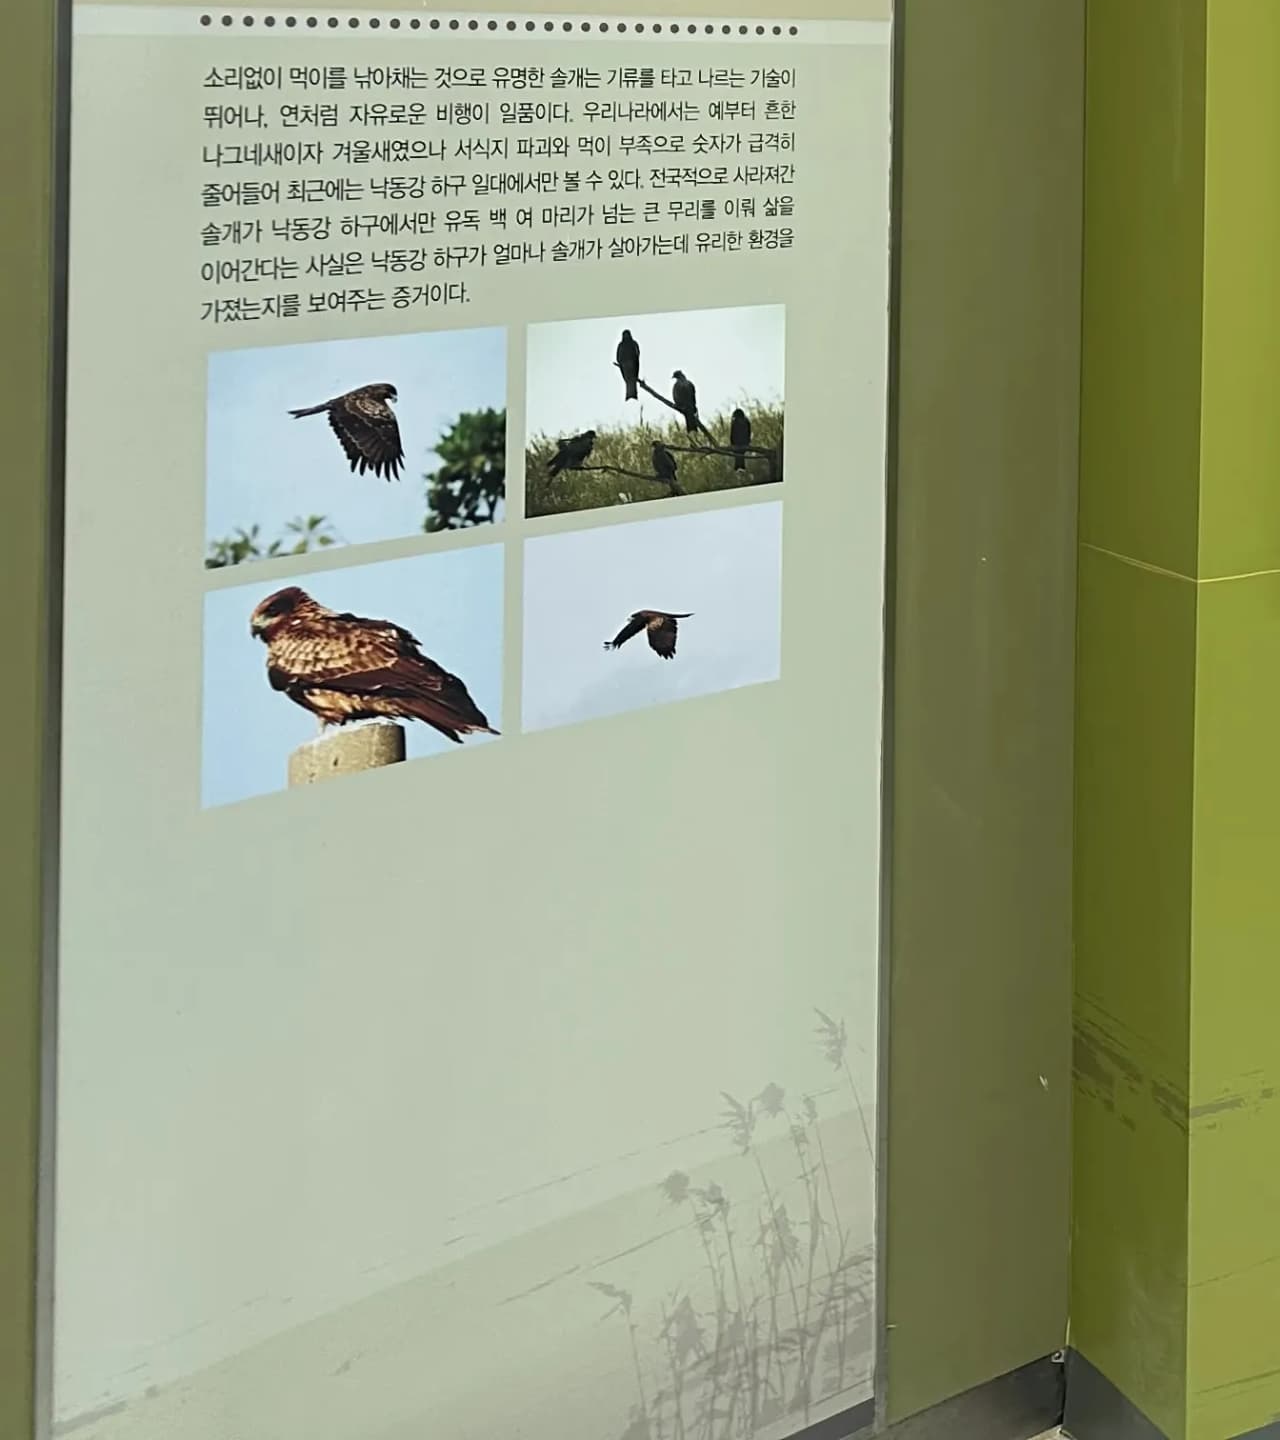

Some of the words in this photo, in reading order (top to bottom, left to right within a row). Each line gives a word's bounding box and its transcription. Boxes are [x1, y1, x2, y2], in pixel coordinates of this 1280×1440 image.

[204, 67, 281, 90] 소리없이
[290, 67, 347, 89] 먹이를
[435, 67, 487, 88] 것으로
[492, 67, 545, 89] 유명한
[550, 68, 601, 88] 솔개는
[607, 68, 655, 88] 기류를
[661, 68, 692, 88] 타고
[699, 69, 745, 88] 나르는
[751, 69, 795, 88] 기술이
[280, 104, 337, 127] 연처럼
[349, 103, 426, 126] 자유로운
[437, 103, 488, 125] 비행이
[500, 102, 573, 123] 일품이다.
[583, 101, 699, 122] 우리나라에서는
[709, 101, 755, 120] 예부터
[765, 100, 796, 119] 흔한
[203, 142, 323, 167] 나그네새이자
[333, 139, 446, 163] 겨울새였으나
[455, 138, 507, 160] 서식지
[517, 137, 569, 158] 파괴와
[578, 136, 610, 156] 먹이
[619, 136, 685, 155] 부족으로
[692, 133, 741, 154] 숫자가
[748, 132, 794, 152] 급격히
[202, 181, 279, 207] 줄어들어
[287, 179, 364, 202] 최근에는
[371, 176, 426, 199] 낙동강
[432, 176, 466, 196] 하구
[472, 172, 558, 195] 일대에서만
[564, 171, 580, 192] 볼
[586, 170, 603, 191] 수
[608, 169, 643, 189] 있다.
[650, 167, 728, 188] 전국적으로
[733, 165, 795, 185] 사라져간
[201, 220, 262, 246] 솔개가
[272, 217, 331, 241] 낙동강
[341, 212, 436, 237] 하구에서만
[444, 210, 480, 232] 유독
[490, 208, 506, 229] 백
[516, 208, 532, 228] 여
[543, 205, 594, 227] 마리가
[603, 203, 635, 224] 넘는
[643, 203, 660, 222] 큰
[668, 200, 716, 221] 무리를
[725, 198, 755, 218] 이뤄
[763, 196, 794, 216] 삶을
[201, 257, 299, 284] 이어간다는
[306, 252, 364, 276] 사실은
[372, 248, 427, 272] 낙동강
[434, 245, 487, 268] 하구가
[494, 241, 545, 265] 얼마나
[552, 238, 603, 261] 솔개가
[609, 234, 688, 258] 살아가는데
[696, 231, 743, 252] 유리한
[748, 228, 794, 249] 환경을
[201, 294, 301, 323] 가졌는지를
[308, 289, 386, 312] 보여주는
[392, 282, 470, 308] 증거이다.
